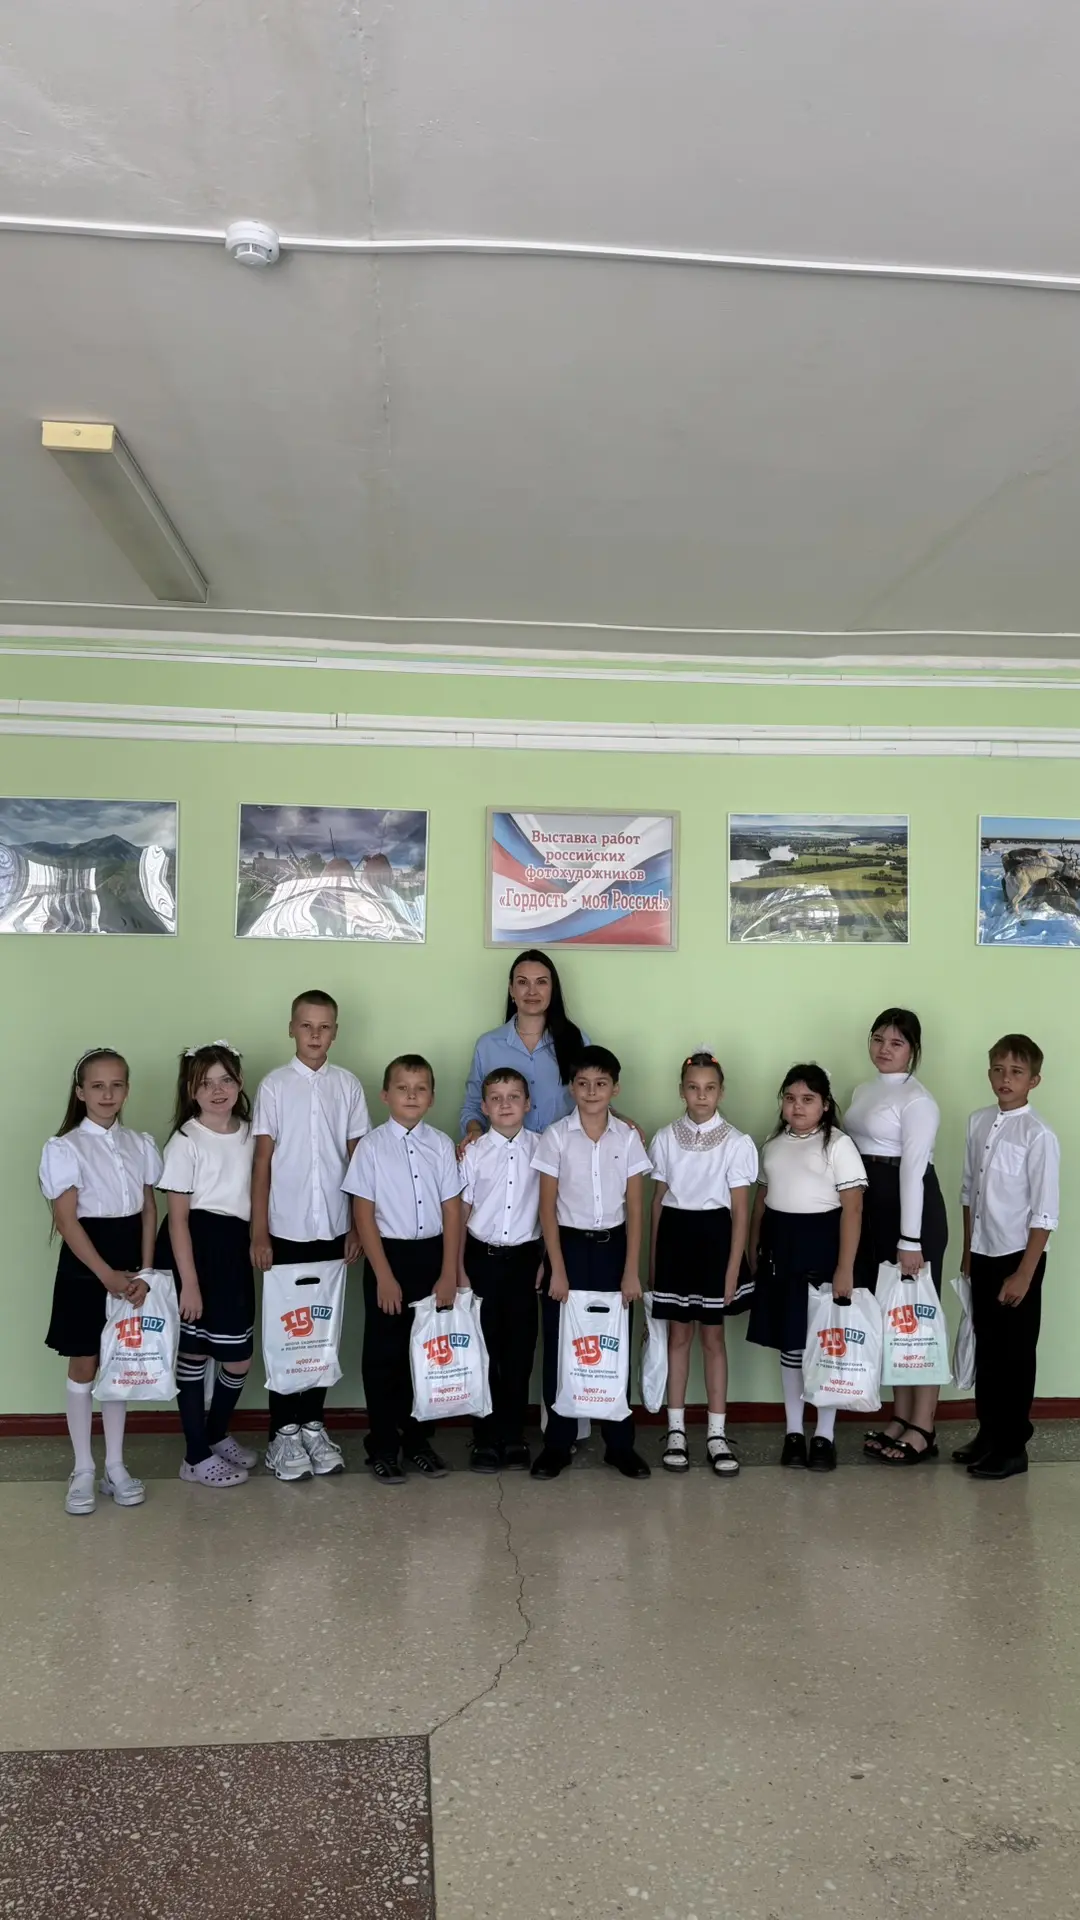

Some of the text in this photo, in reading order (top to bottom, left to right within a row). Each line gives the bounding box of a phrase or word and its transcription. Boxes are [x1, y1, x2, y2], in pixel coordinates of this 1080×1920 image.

[531, 830, 641, 847] Выставка работ
[545, 849, 625, 863] российских
[525, 865, 645, 881] фотохудожников
[499, 888, 568, 912] «Гордость
[581, 894, 608, 909] моя
[612, 890, 670, 911] Россия!»
[312, 1306, 332, 1319] 007
[916, 1305, 936, 1318] 007
[142, 1317, 165, 1330] 007
[450, 1335, 469, 1347] 007
[601, 1336, 620, 1350] 007
[845, 1329, 865, 1343] 007
